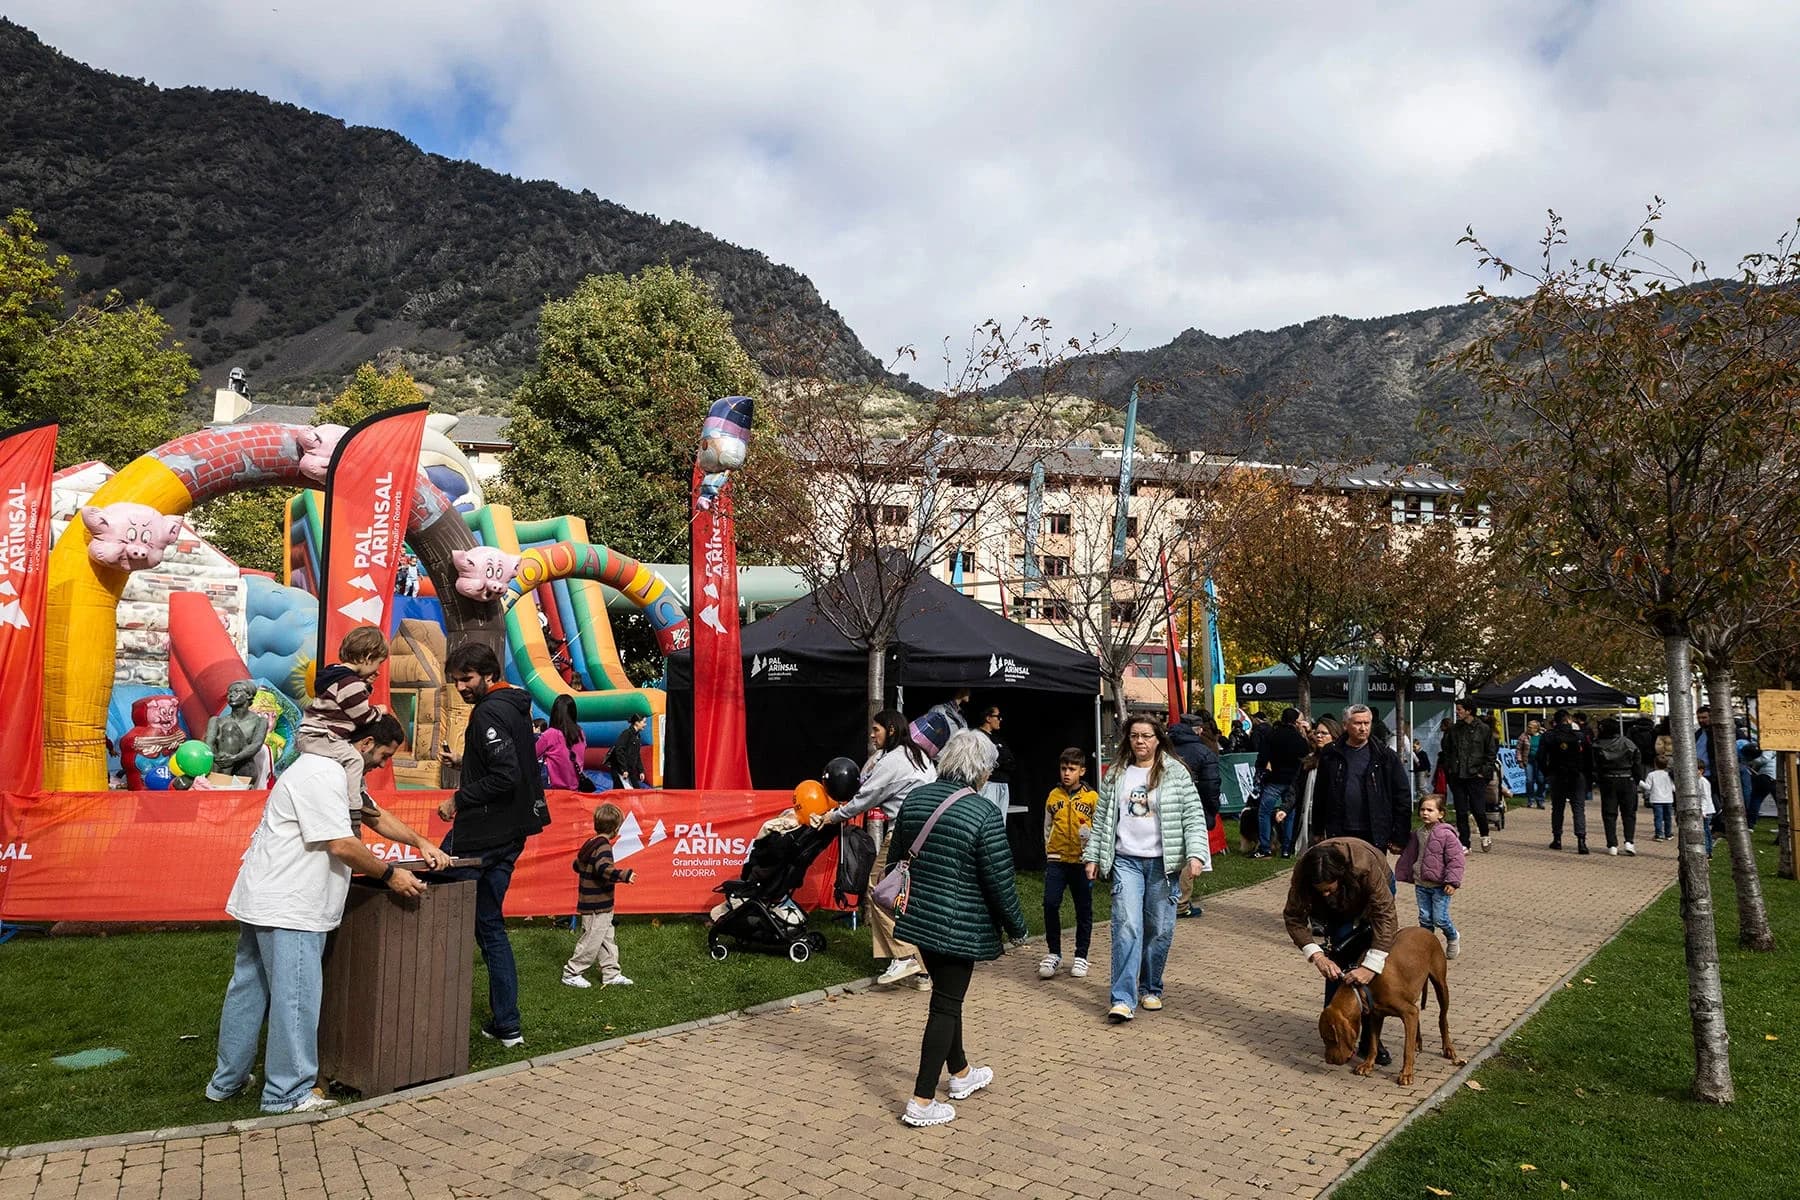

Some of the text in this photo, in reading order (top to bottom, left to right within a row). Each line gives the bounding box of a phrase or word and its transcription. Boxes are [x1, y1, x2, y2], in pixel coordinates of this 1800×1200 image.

[392, 491, 402, 521] Resorts
[9, 482, 26, 574] ARINSAL
[371, 471, 393, 568] ARINSAL
[354, 526, 372, 568] PAL
[768, 657, 781, 665] PAL
[1512, 696, 1577, 705] BURTON
[674, 822, 718, 838] PAL
[365, 842, 417, 860] SAL
[672, 858, 744, 867] Grandvalira Reso
[672, 869, 716, 877] ANDORRA
